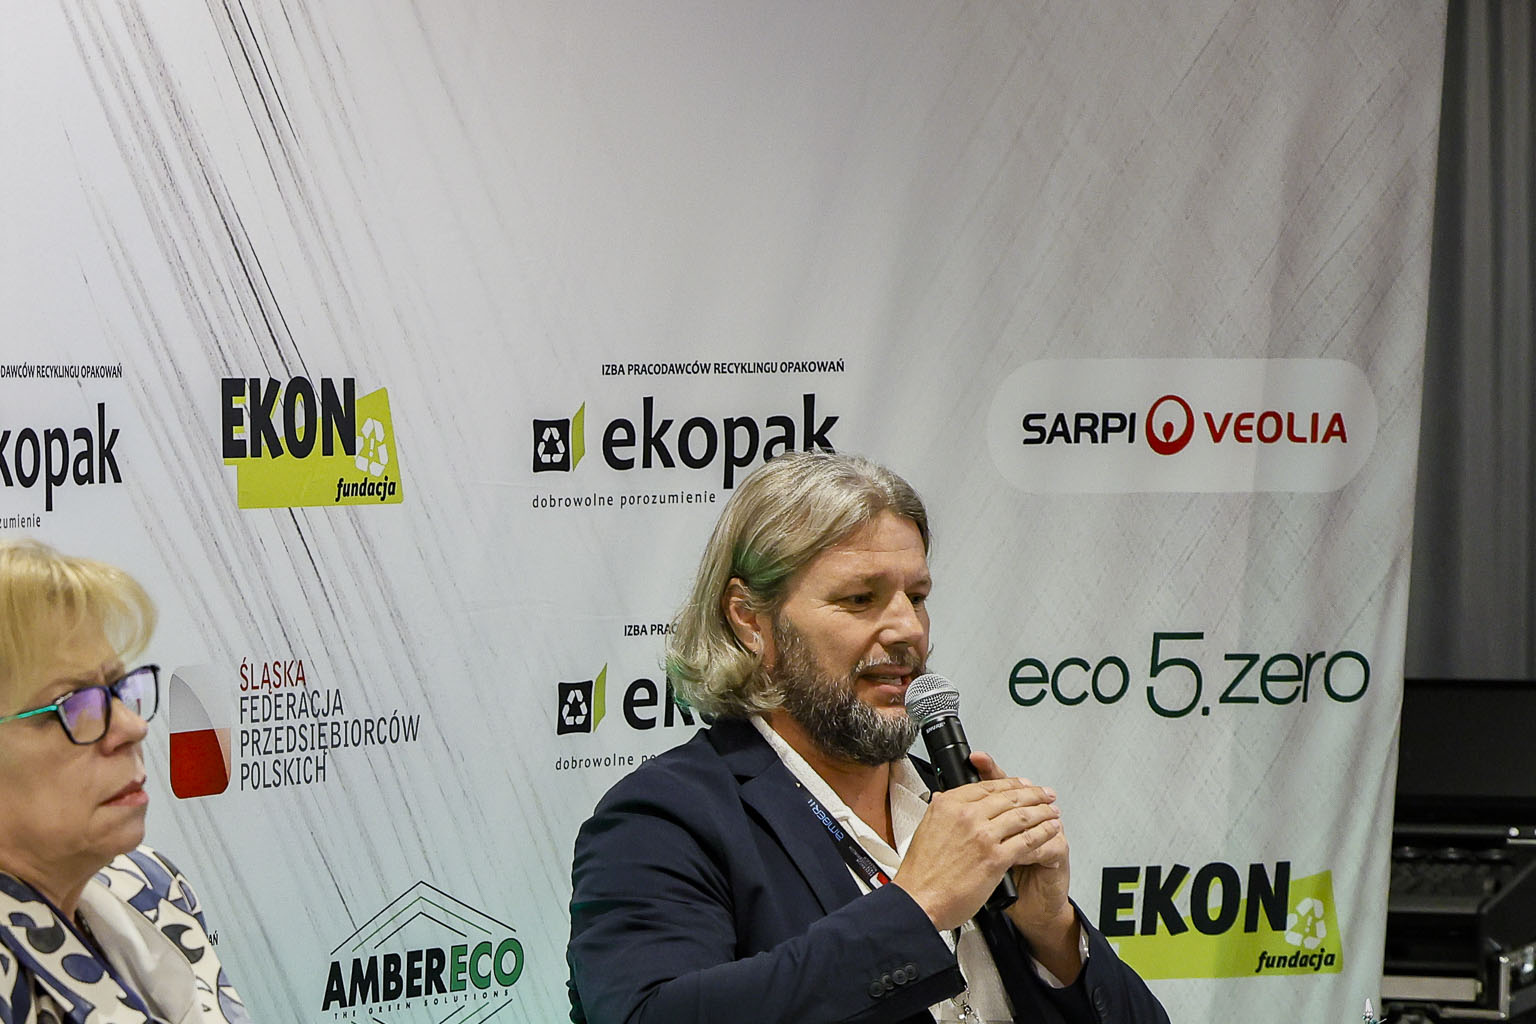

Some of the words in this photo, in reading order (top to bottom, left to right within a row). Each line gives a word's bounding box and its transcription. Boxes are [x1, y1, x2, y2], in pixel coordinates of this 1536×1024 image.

[37, 365, 80, 379] RECYKLINGU
[81, 362, 123, 378] OPAKOWAŃ
[601, 364, 625, 376] IZBA
[627, 360, 711, 376] PRACODAWCÓW
[714, 362, 778, 374] RECYKLINGU
[780, 358, 845, 373] OPAKOWAŃ
[221, 376, 357, 459] EKON
[1022, 412, 1137, 445] SARPI
[1203, 411, 1348, 444] VEOLIA
[602, 393, 840, 490] ekopak
[335, 475, 396, 502] fundacja
[532, 493, 614, 508] dobrowolne
[620, 491, 716, 509] porozumienie
[624, 624, 648, 636] IZBA
[239, 657, 306, 694] ŚLĄSKA
[1009, 656, 1130, 707] eco
[240, 688, 344, 725] FEDERACJA
[240, 709, 420, 758] PRZEDSIĘBIORCÓW
[241, 755, 327, 791] POLSKICH
[556, 753, 634, 770] dobrowolne
[1099, 861, 1291, 937] EKON
[322, 938, 524, 1011] AMBERECO
[1255, 948, 1336, 973] fundacja
[334, 1010, 356, 1020] THE
[424, 989, 509, 1006] SOLUTIONS
